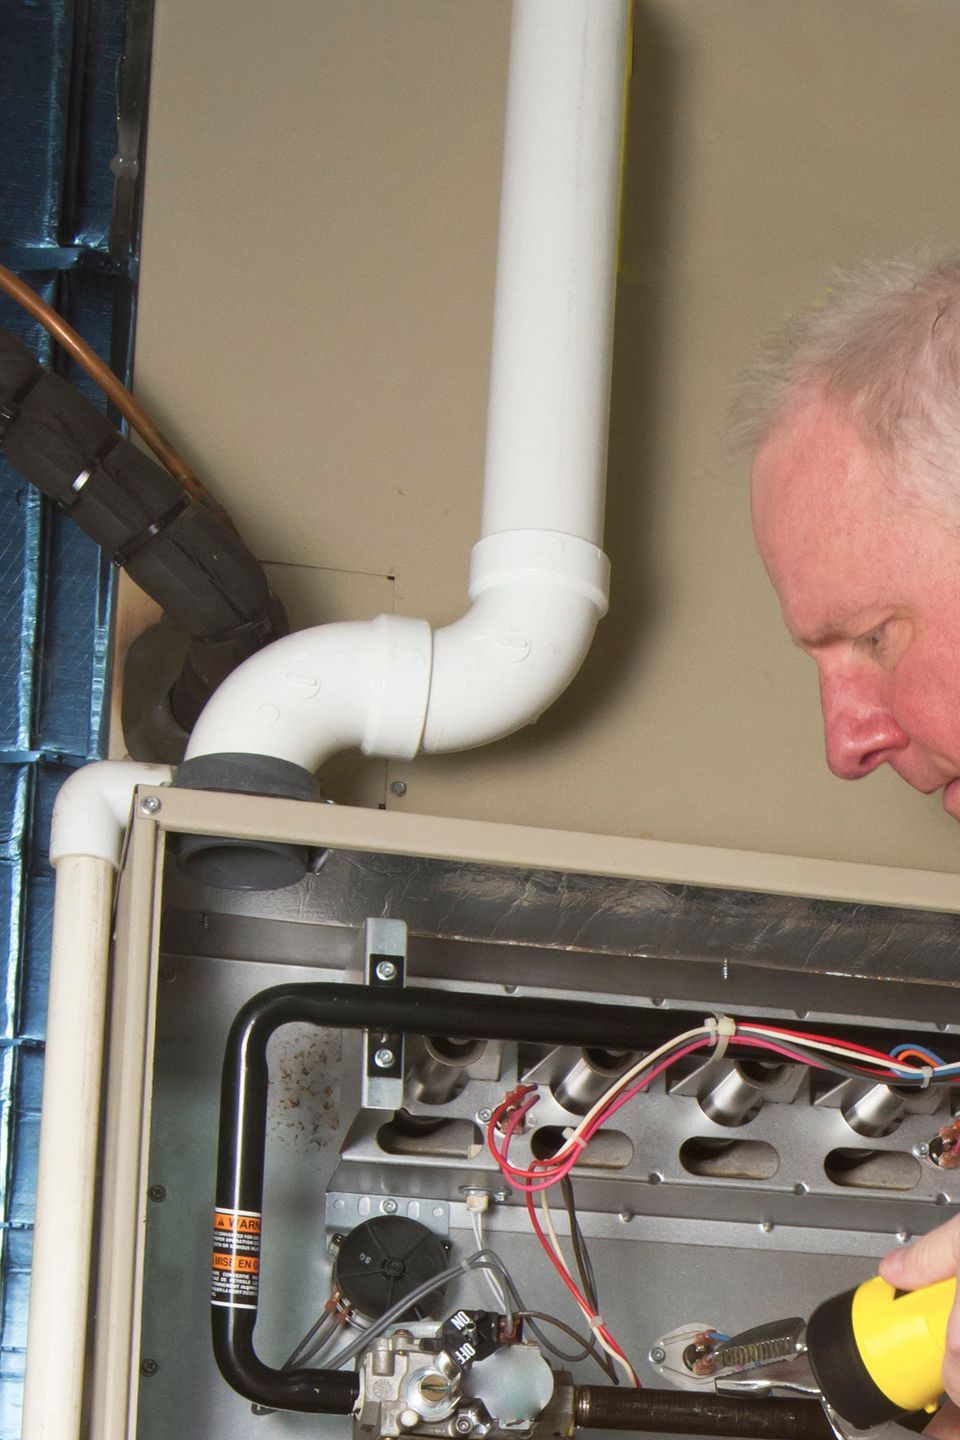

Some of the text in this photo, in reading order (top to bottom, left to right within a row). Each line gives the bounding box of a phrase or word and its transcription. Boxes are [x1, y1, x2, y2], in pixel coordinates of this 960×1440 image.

[238, 1259, 252, 1269] EN
[450, 1310, 471, 1331] ON
[455, 1342, 476, 1365] OFF
